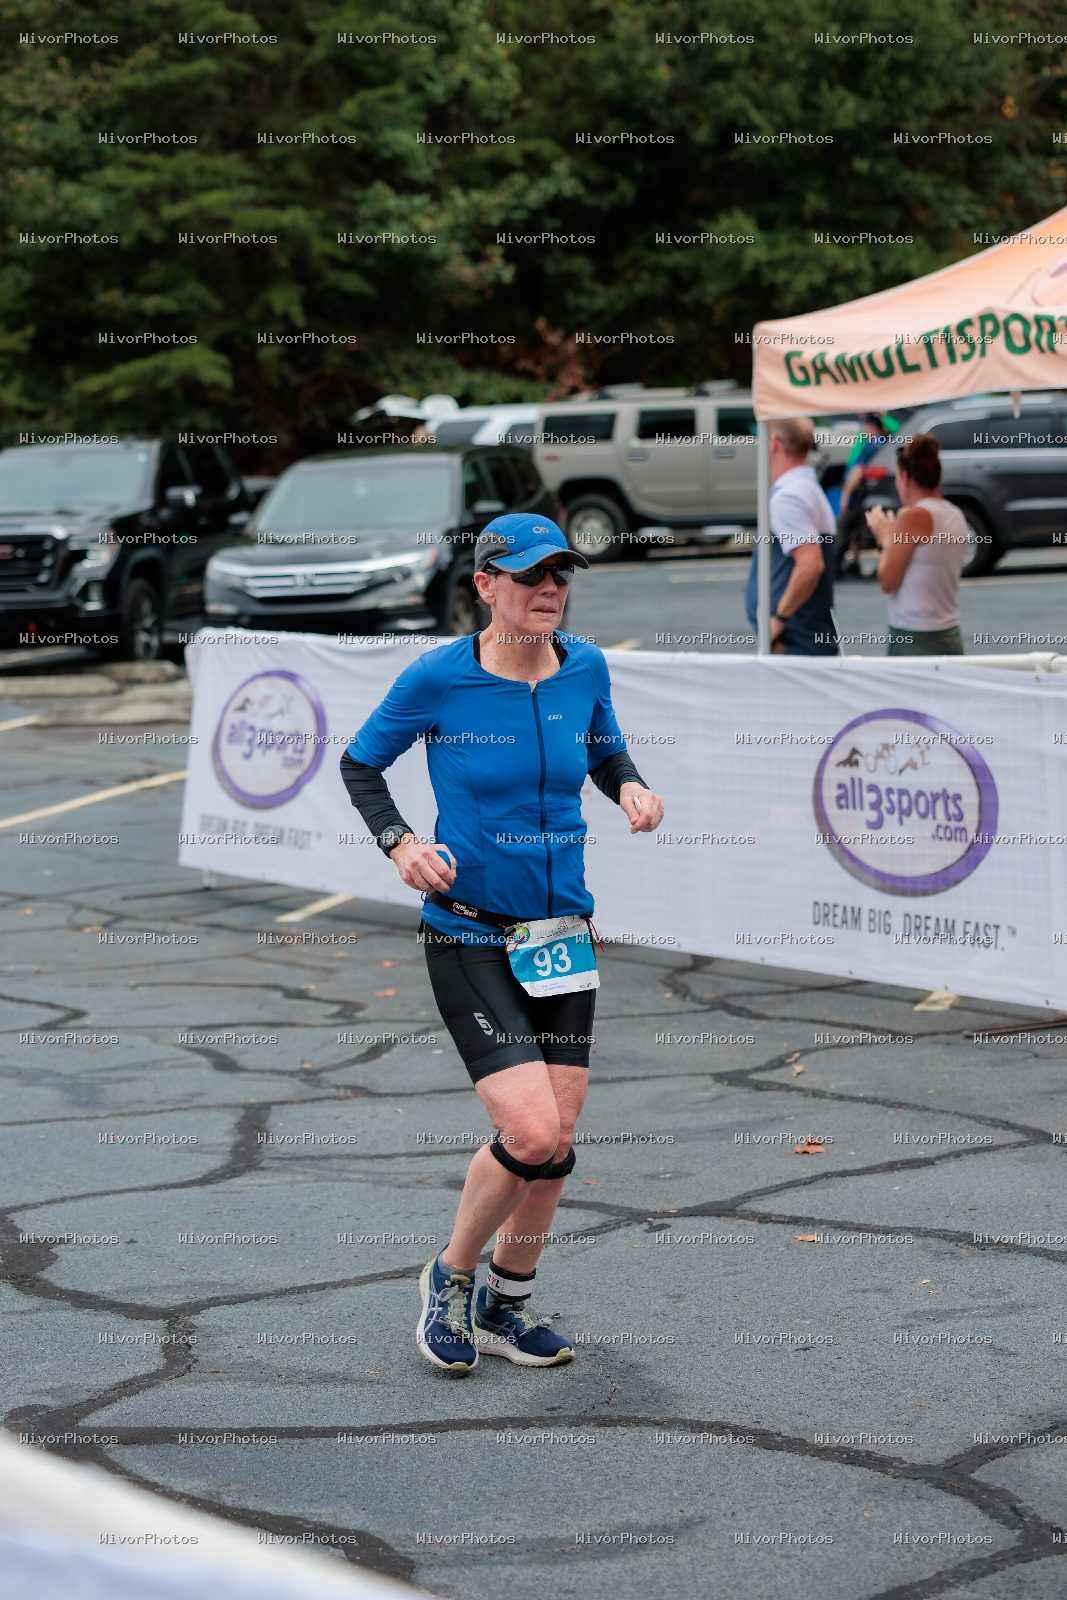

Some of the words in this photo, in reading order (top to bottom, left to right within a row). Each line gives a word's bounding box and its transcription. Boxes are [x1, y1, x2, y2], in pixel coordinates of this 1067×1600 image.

[835, 776, 963, 830] all3sports
[931, 824, 969, 843] .com
[812, 900, 862, 932] DREAM
[903, 912, 956, 945] DREAM
[533, 942, 572, 977] 93
